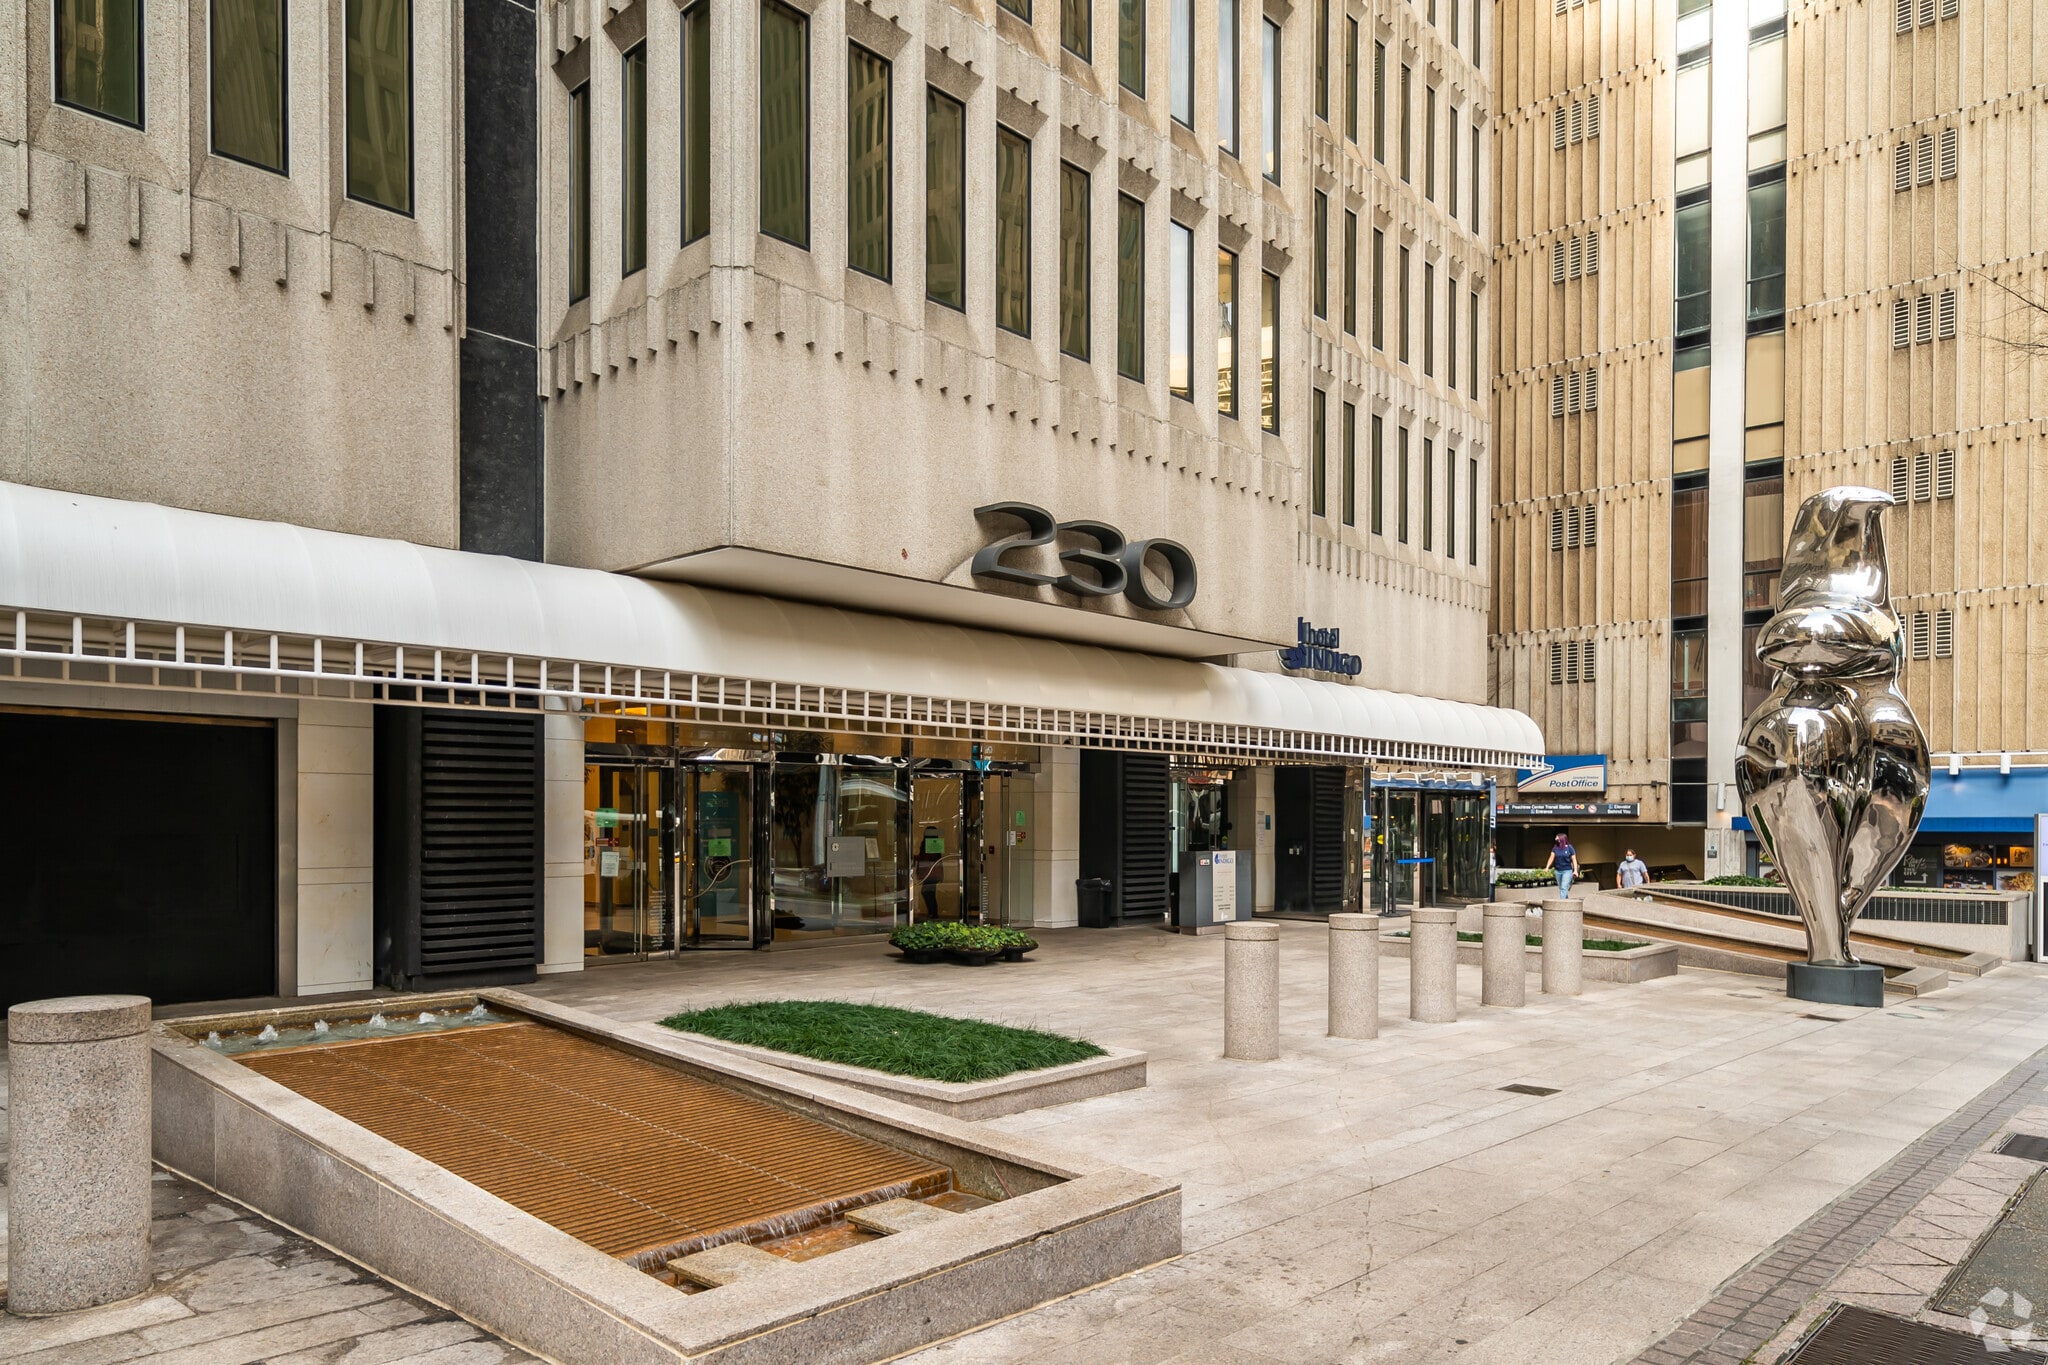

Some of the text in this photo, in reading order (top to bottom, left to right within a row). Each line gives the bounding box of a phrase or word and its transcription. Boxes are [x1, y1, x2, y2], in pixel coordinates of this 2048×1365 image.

[971, 501, 1197, 610] 230
[1302, 621, 1339, 648] hotel
[1305, 645, 1362, 675] INDIGO
[1570, 779, 1599, 787] Office
